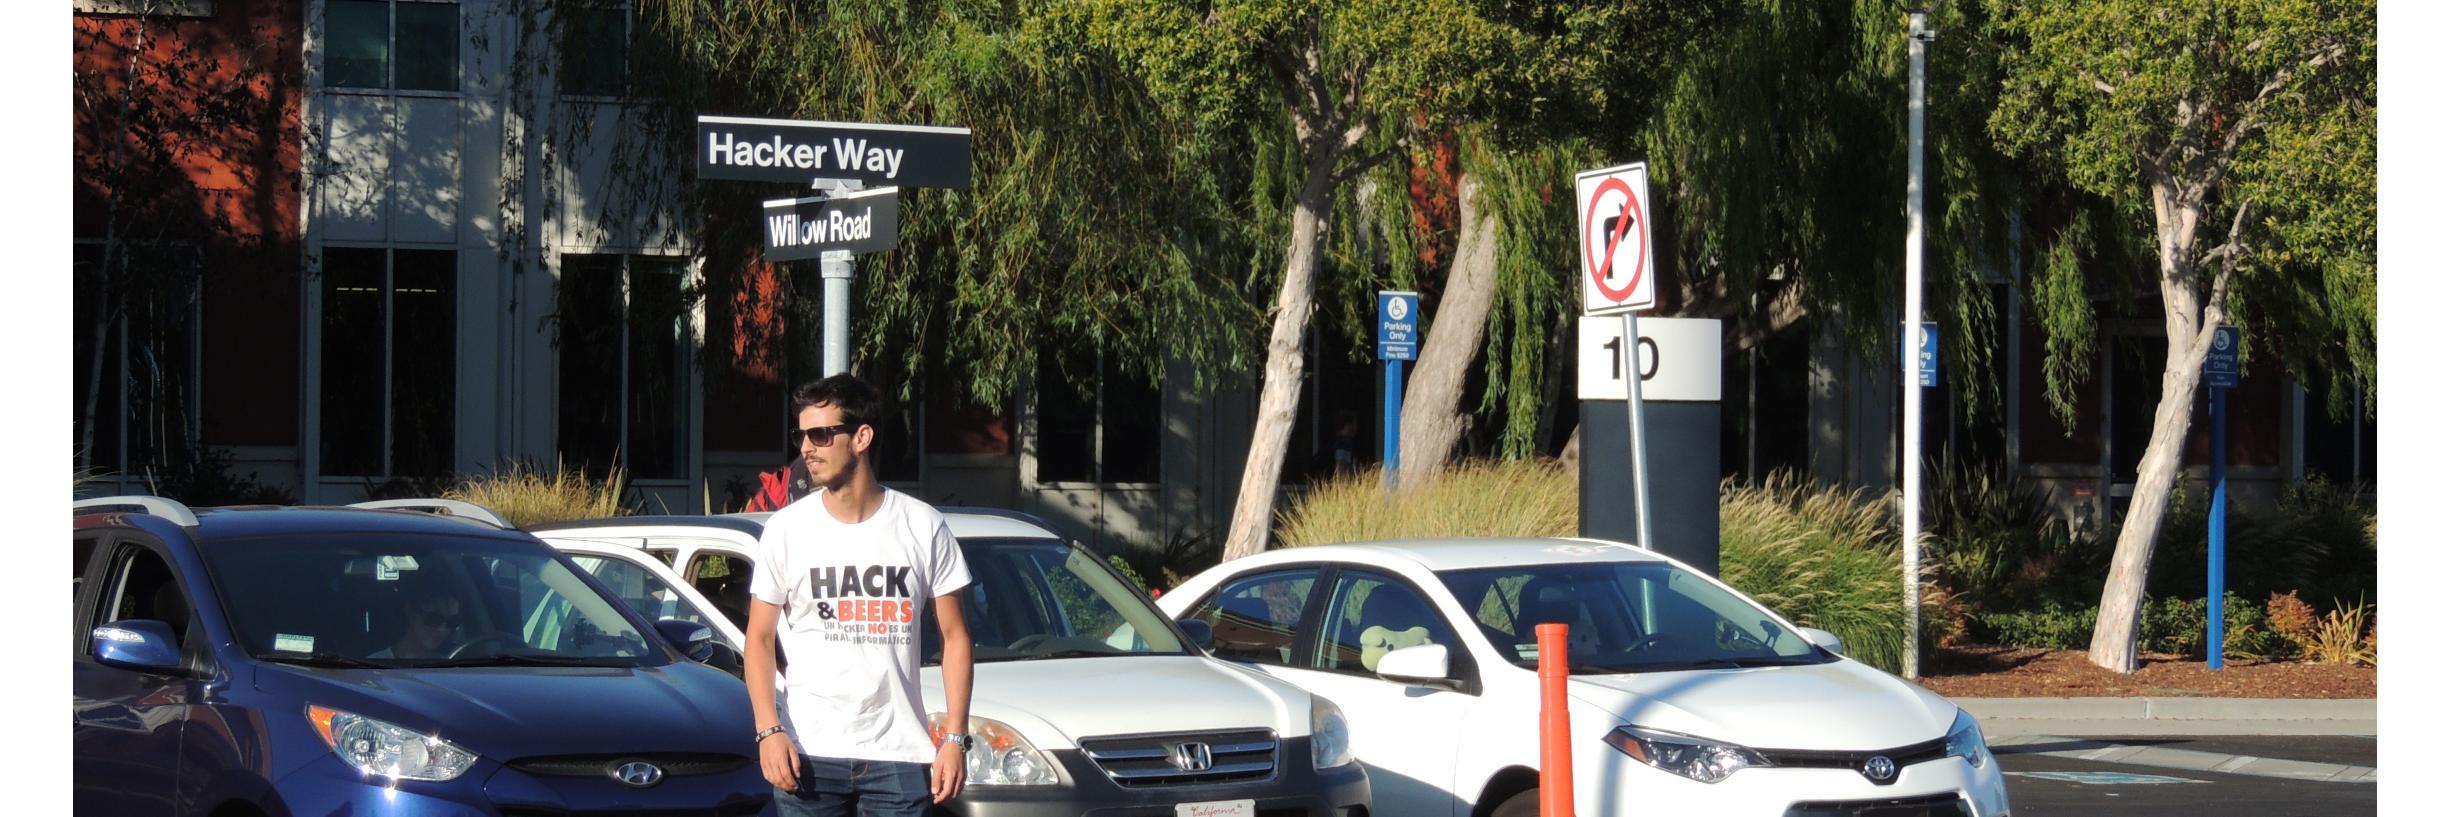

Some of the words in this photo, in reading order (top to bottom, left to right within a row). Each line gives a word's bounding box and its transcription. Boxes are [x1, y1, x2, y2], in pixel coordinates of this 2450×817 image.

[709, 132, 827, 169] Hacker
[833, 138, 904, 179] Way
[769, 214, 827, 247] Willow
[830, 206, 871, 242] Road
[1384, 322, 1412, 333] Parking
[1389, 331, 1407, 341] Only
[1603, 336, 1660, 381] 10
[810, 565, 911, 599] HACK
[816, 602, 837, 620] &
[838, 600, 913, 623] BEERS
[824, 622, 835, 631] UN
[868, 623, 888, 635] NO
[888, 624, 899, 633] ES
